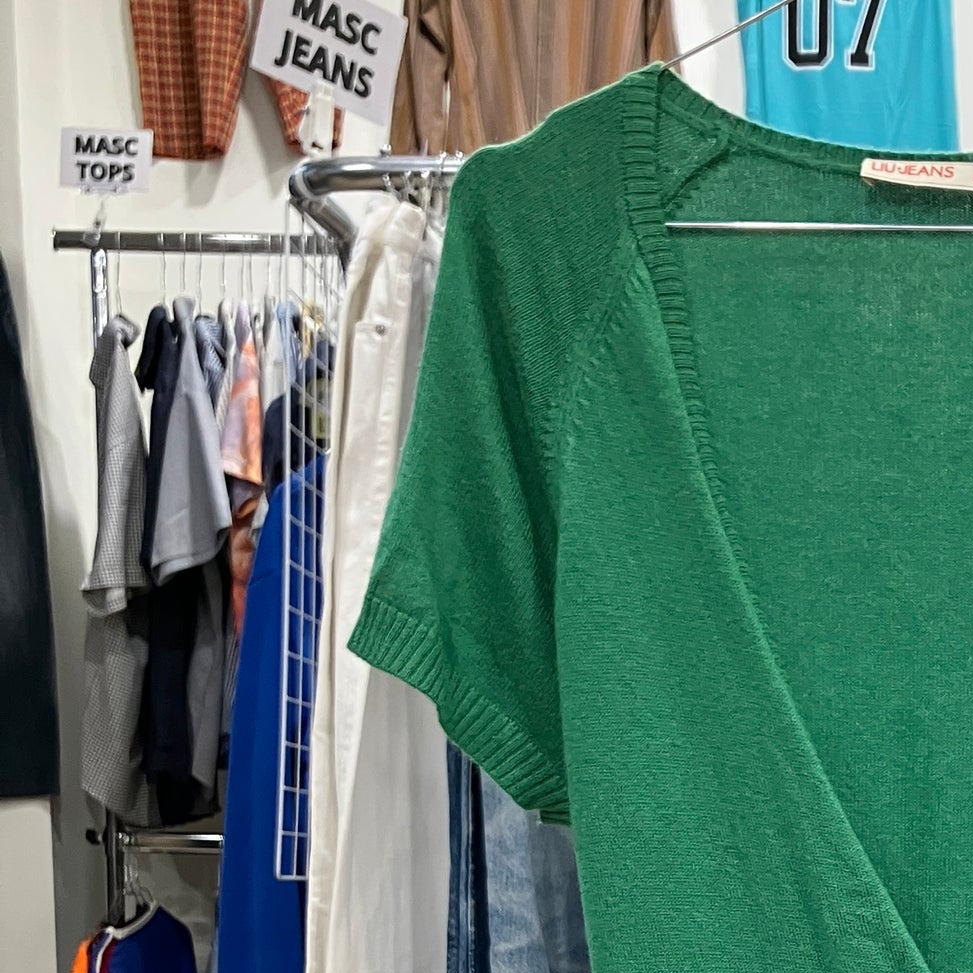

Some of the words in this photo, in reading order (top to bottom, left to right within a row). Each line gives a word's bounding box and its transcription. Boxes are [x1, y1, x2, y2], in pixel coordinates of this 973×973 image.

[292, 0, 382, 55] MASC
[781, 0, 886, 71] 07
[274, 29, 375, 98] JEANS
[75, 134, 138, 156] MASC
[76, 160, 136, 183] TOPS
